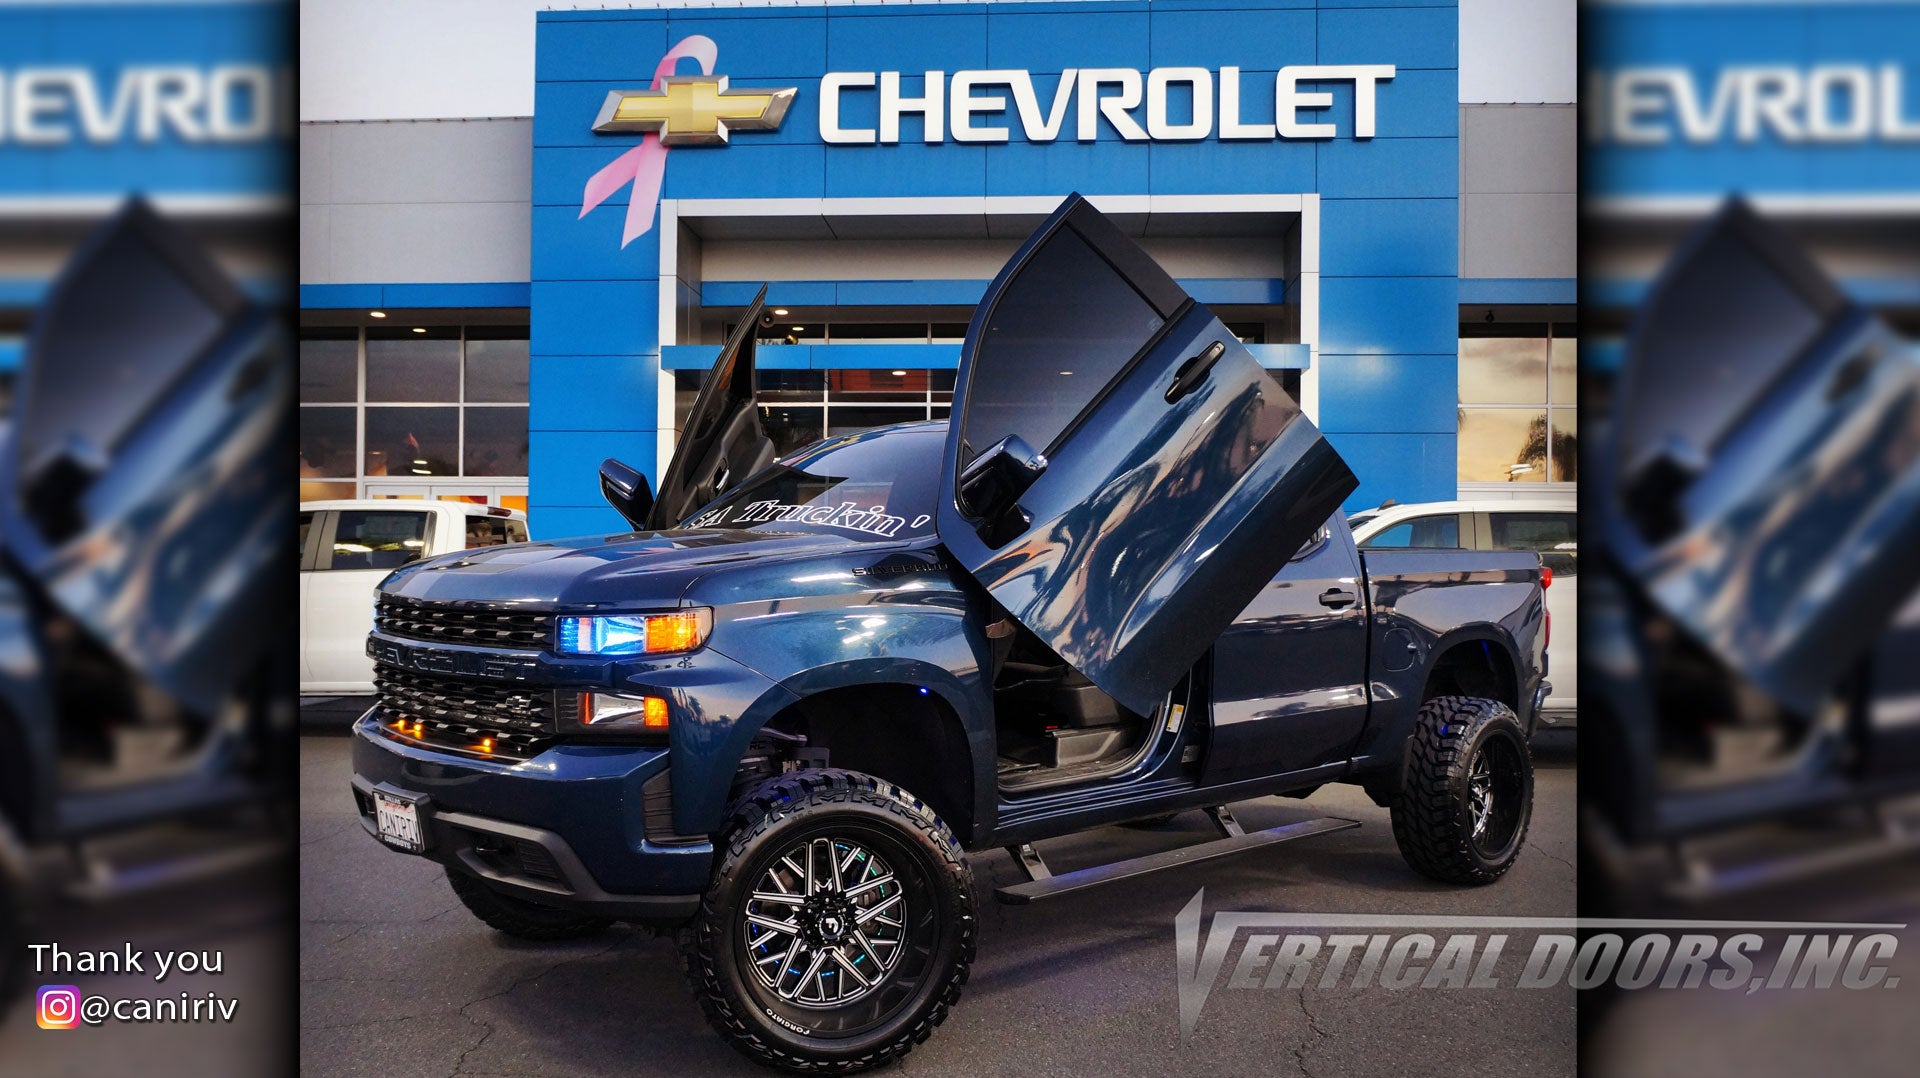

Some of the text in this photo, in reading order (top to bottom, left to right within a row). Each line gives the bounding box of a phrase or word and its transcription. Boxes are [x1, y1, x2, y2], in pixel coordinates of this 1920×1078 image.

[0, 66, 295, 143] EVRO
[819, 64, 1396, 142] CHEVROLET
[766, 1008, 810, 1035] FORGIATO
